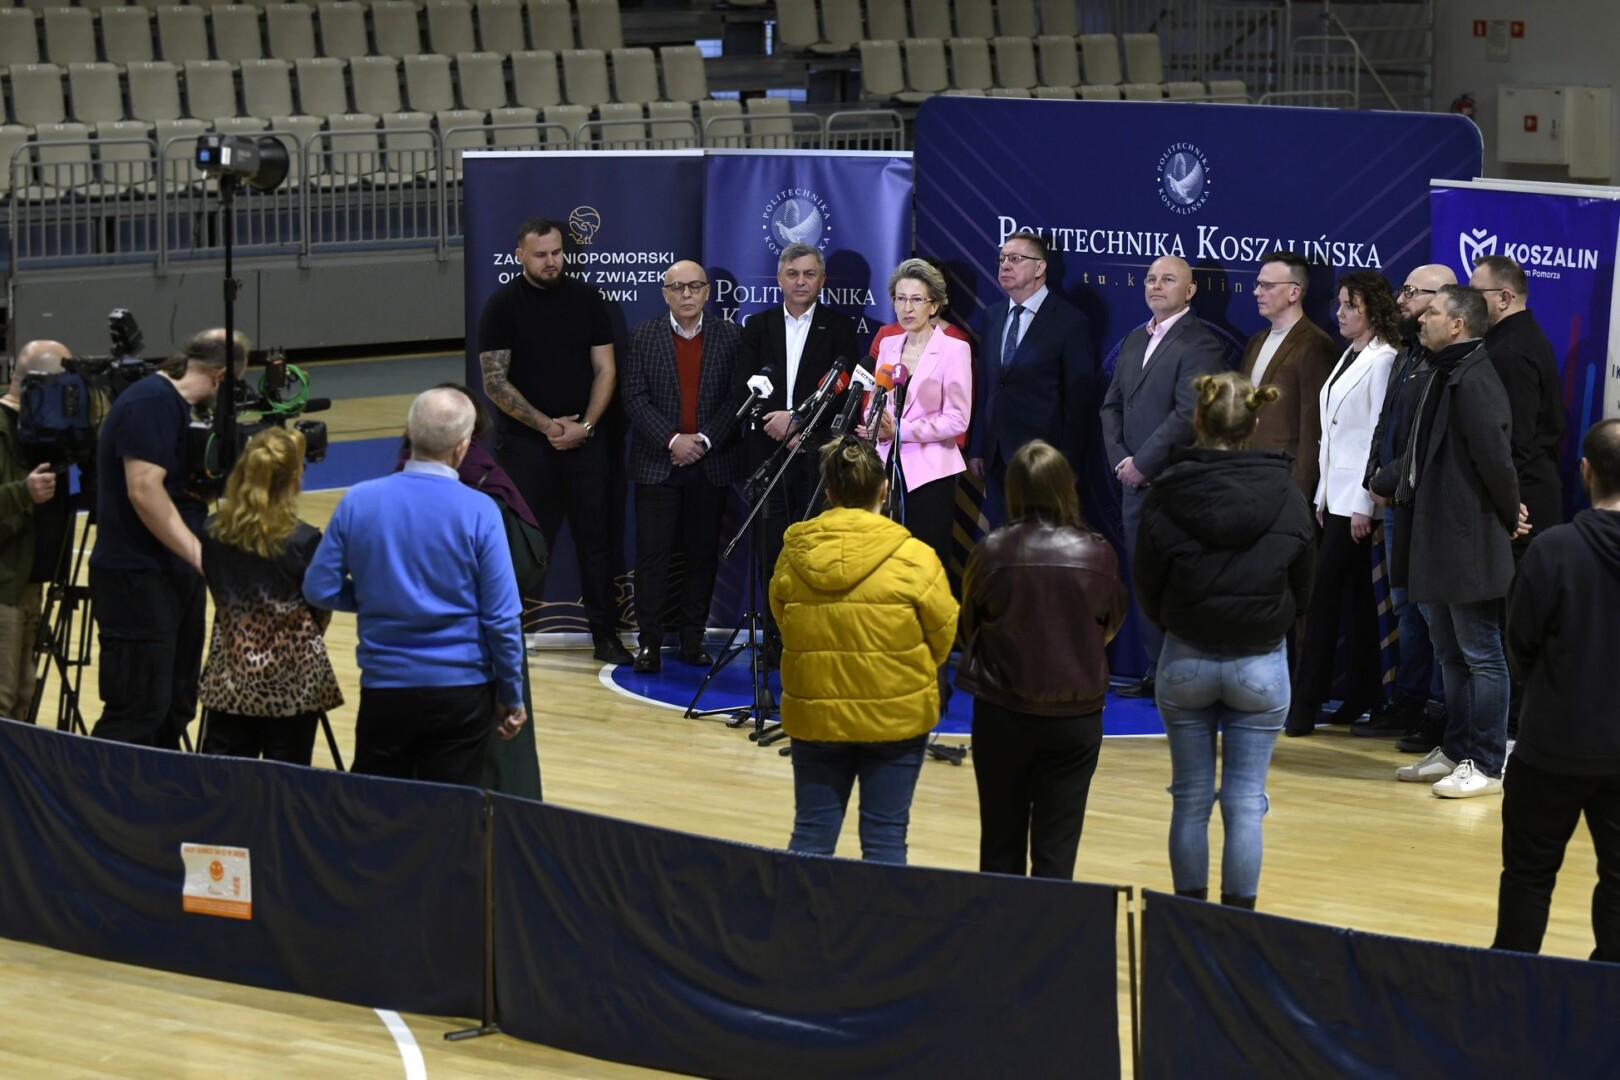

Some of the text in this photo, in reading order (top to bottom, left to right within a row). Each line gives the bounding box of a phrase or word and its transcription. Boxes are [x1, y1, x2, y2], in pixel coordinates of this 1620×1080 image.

[1157, 142, 1210, 173] POLITECHNIKA
[762, 188, 831, 220] POLITECHNIKA
[493, 251, 675, 266] ZACNIOPOMORSKI
[1504, 242, 1599, 270] KOSZALIN
[596, 271, 667, 285] ZWIĄZEK
[1532, 268, 1561, 280] Pomorza
[715, 279, 877, 306] POLITHNIKA
